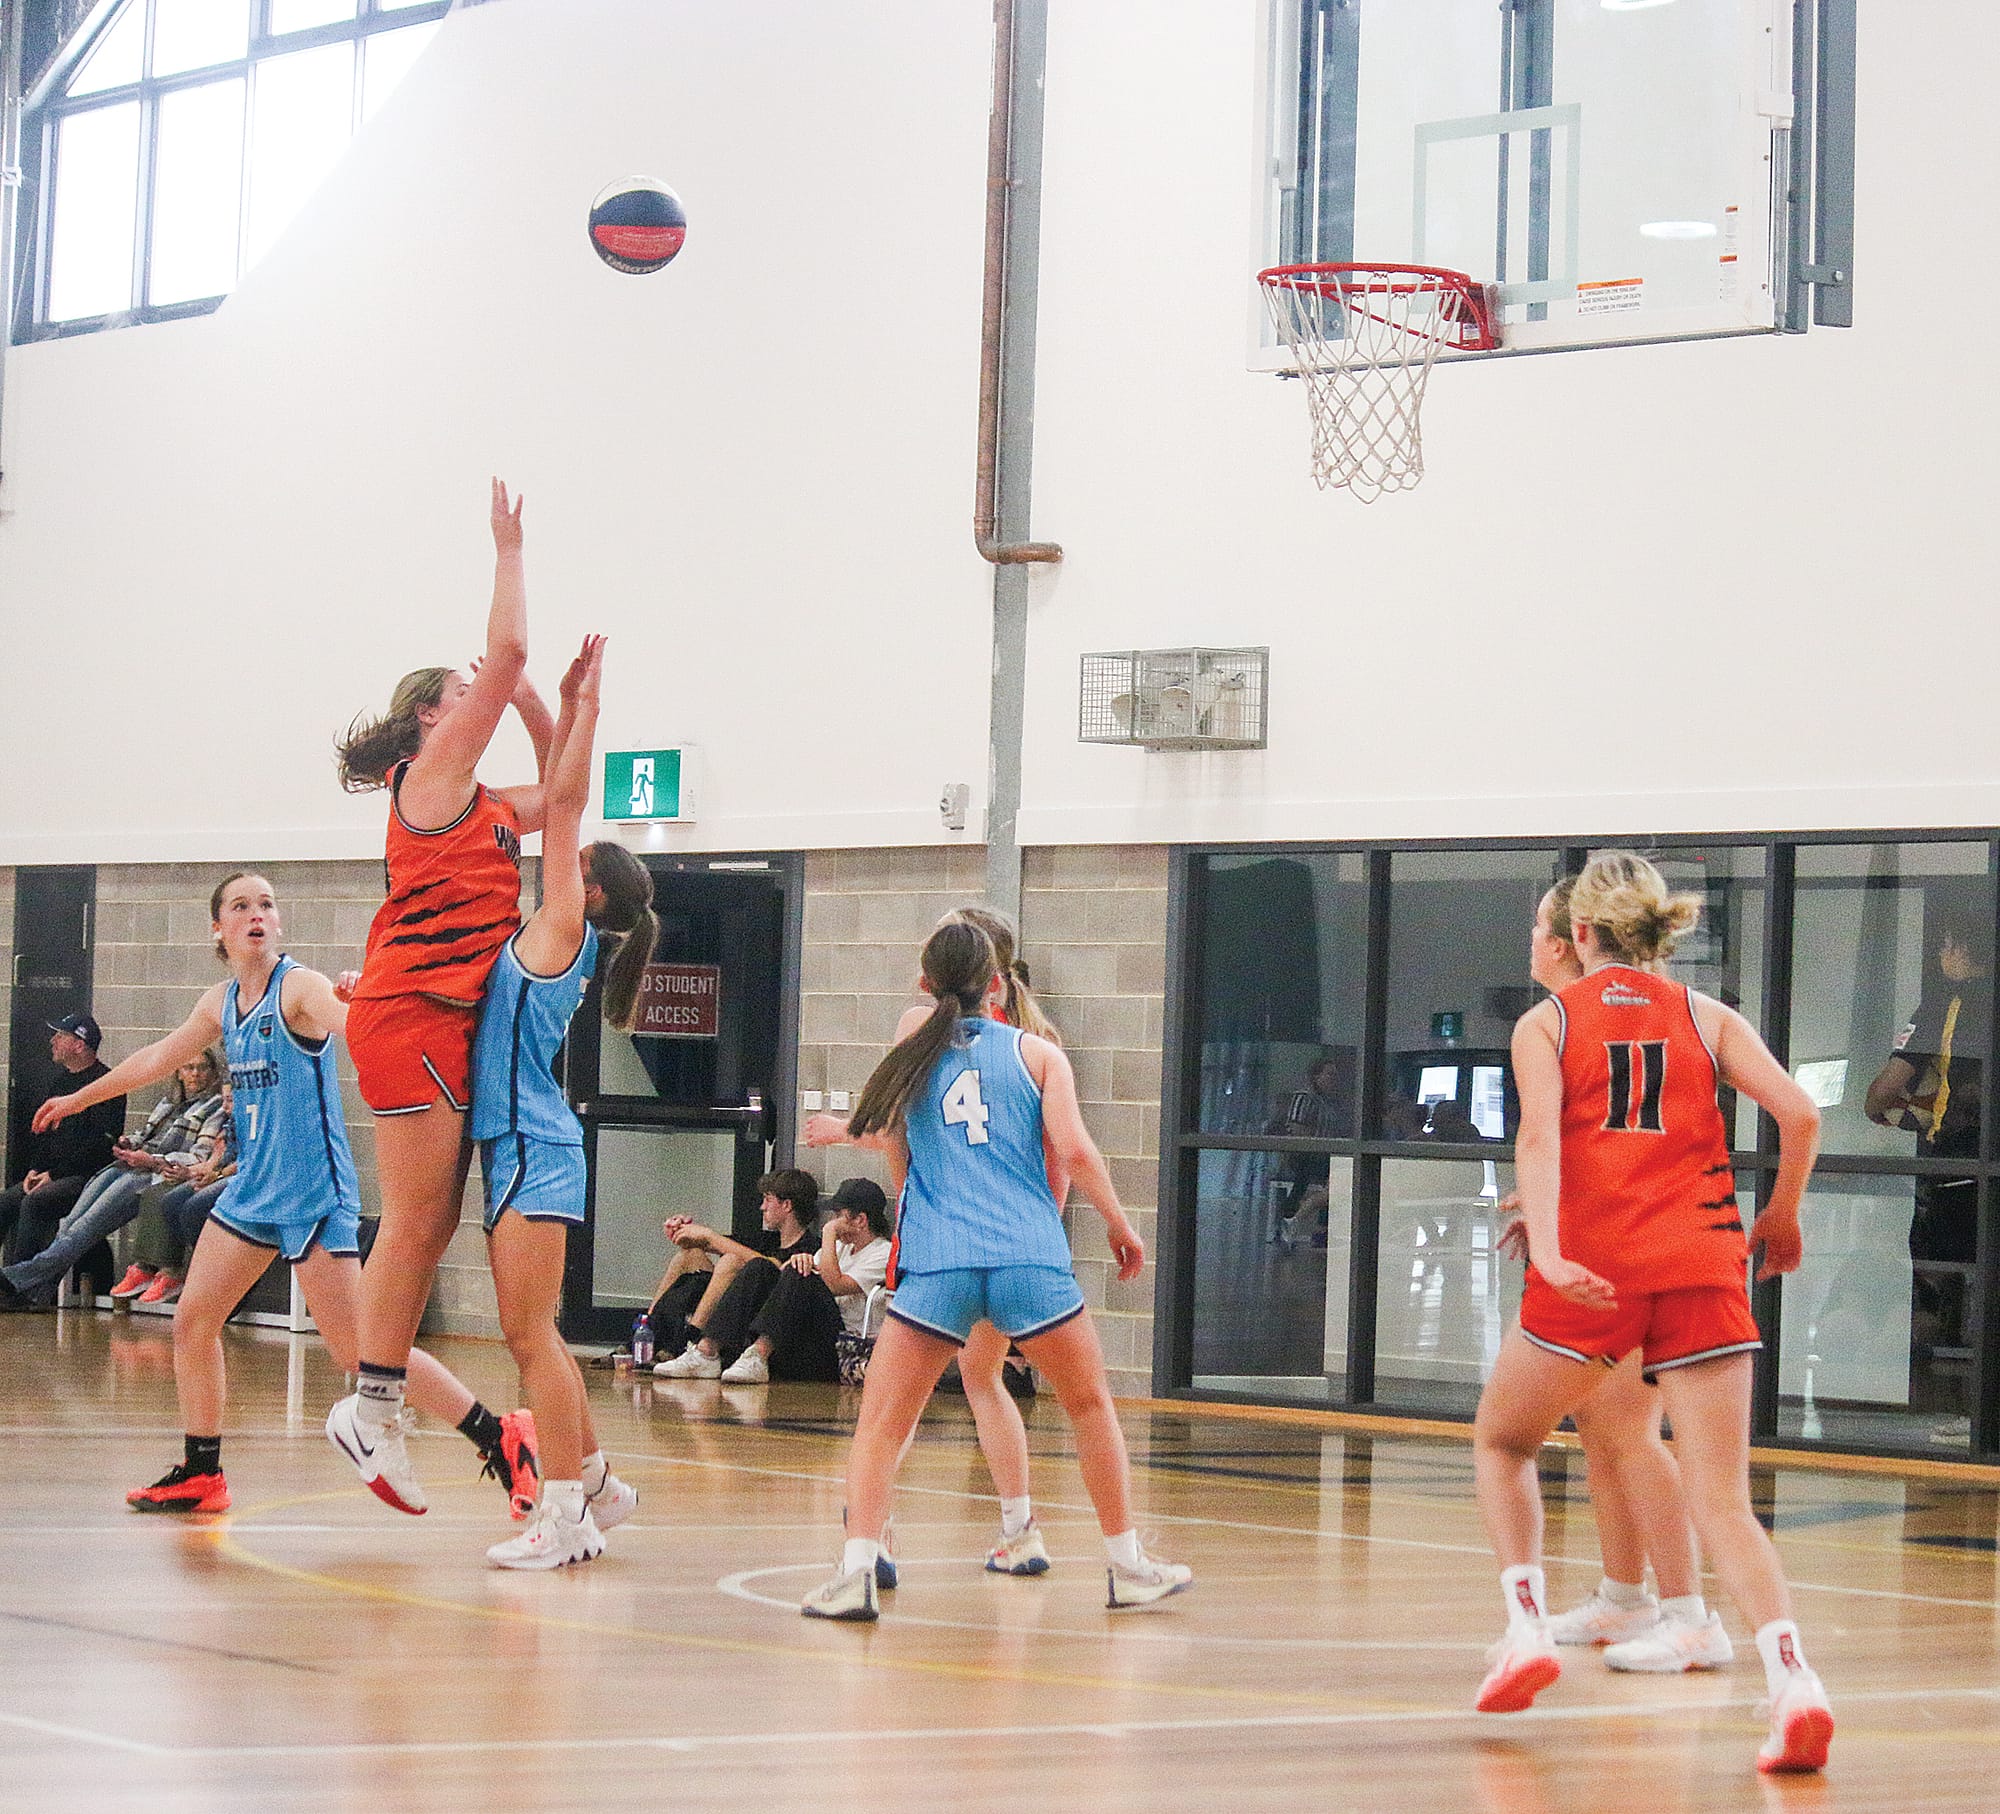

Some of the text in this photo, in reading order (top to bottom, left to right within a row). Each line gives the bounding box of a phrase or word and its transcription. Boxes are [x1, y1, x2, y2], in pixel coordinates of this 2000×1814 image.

[655, 974, 716, 994] STUDENT
[645, 1005, 699, 1025] ACCESS
[940, 1068, 991, 1147] 4
[1600, 1038, 1669, 1134] 11
